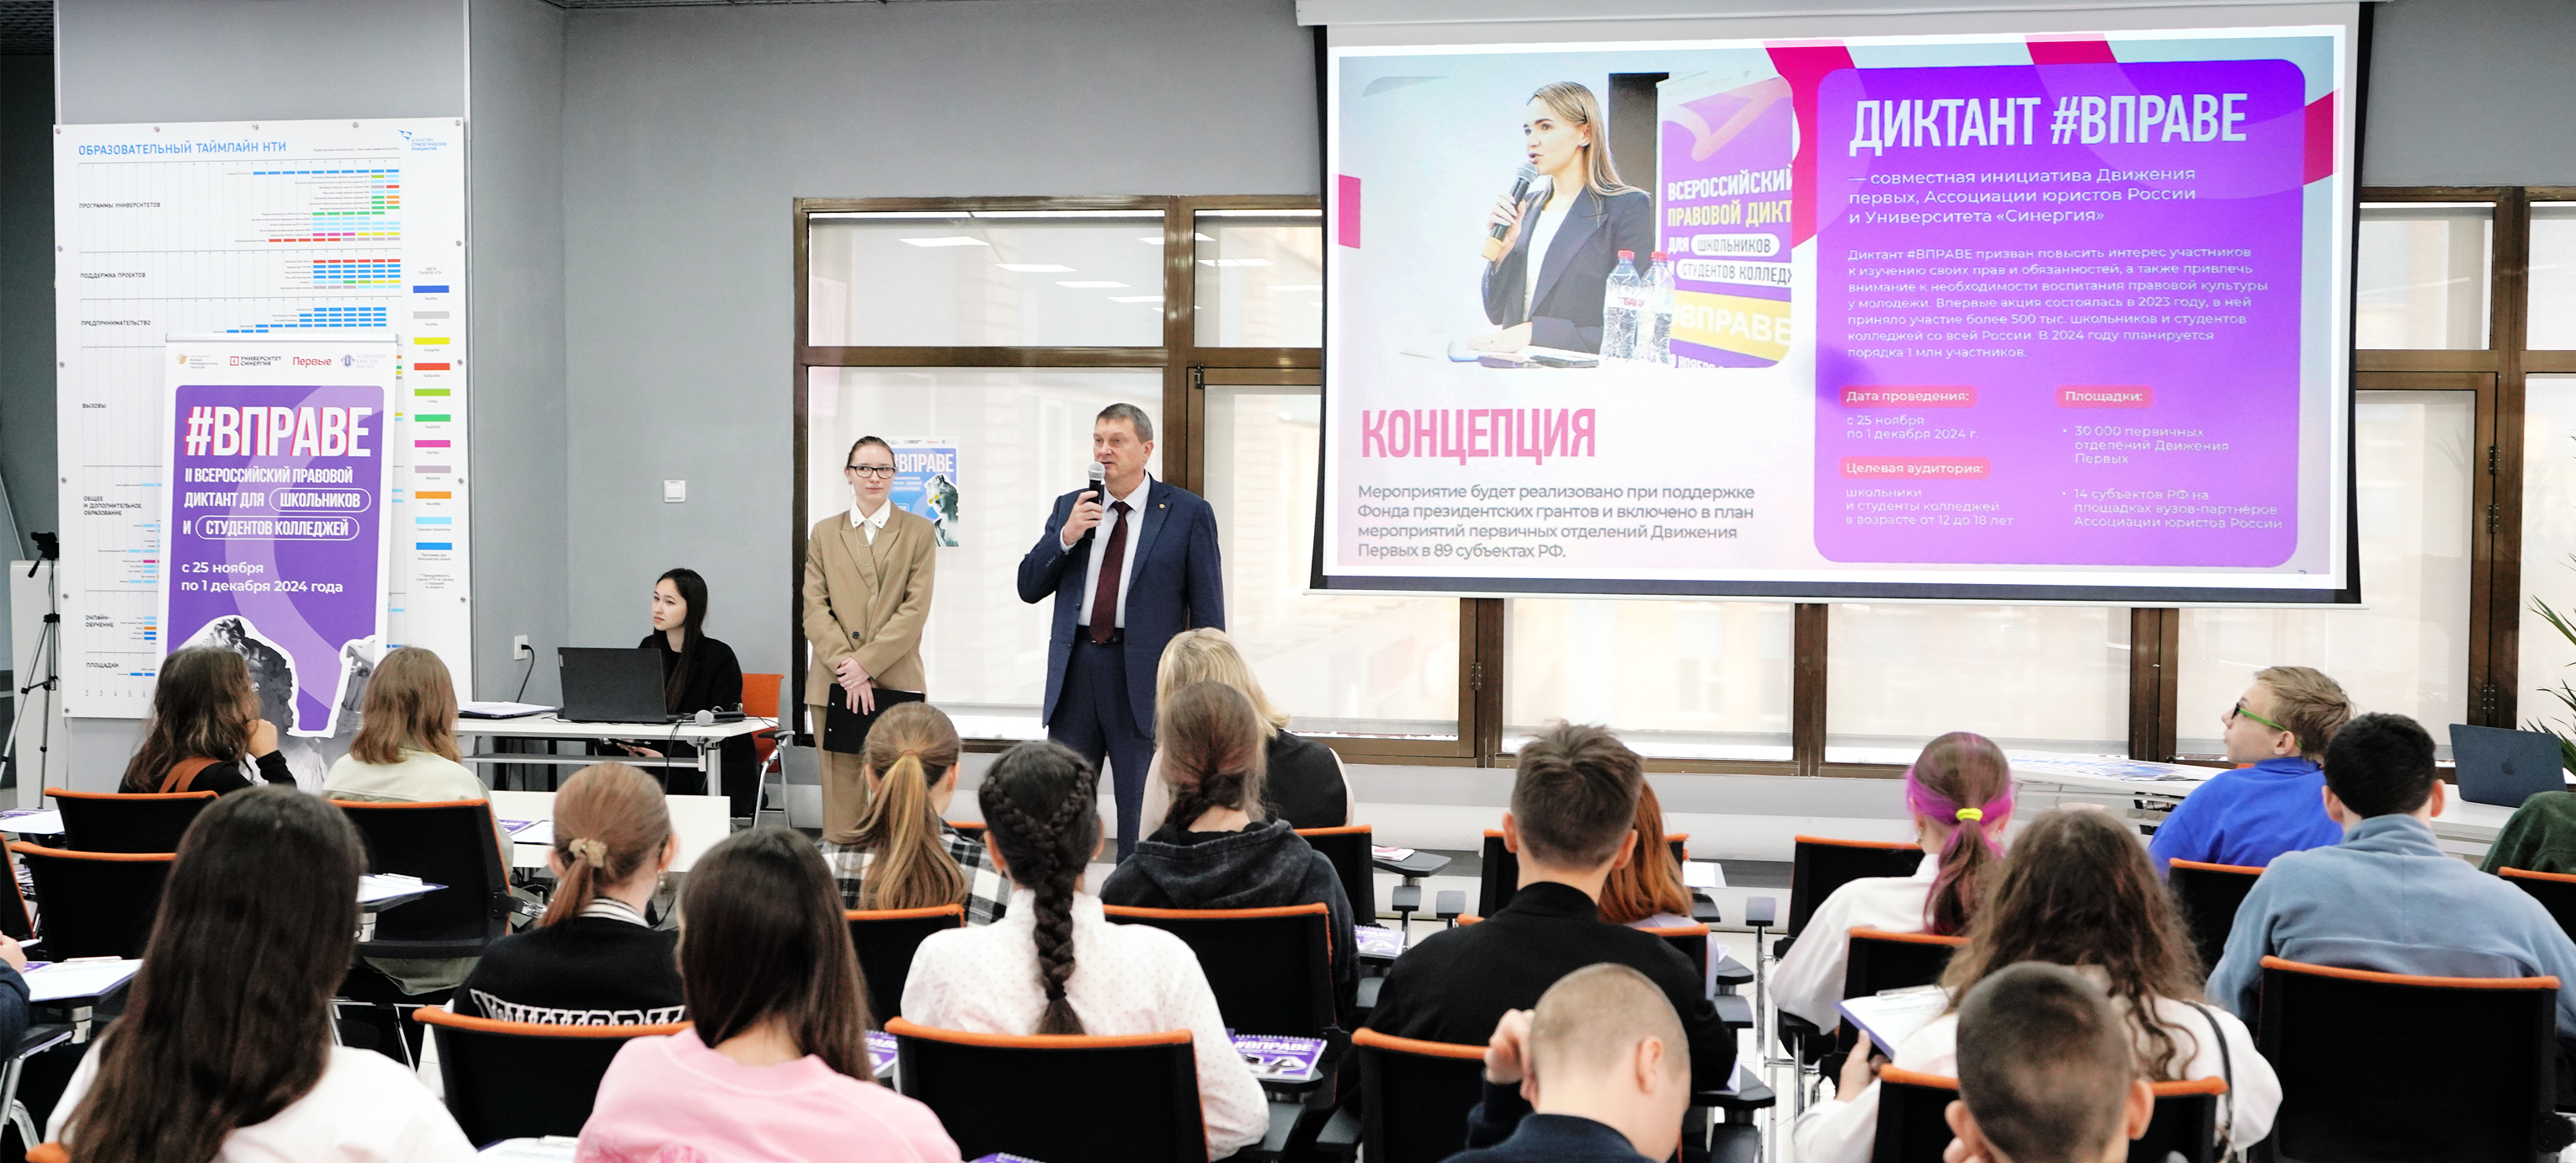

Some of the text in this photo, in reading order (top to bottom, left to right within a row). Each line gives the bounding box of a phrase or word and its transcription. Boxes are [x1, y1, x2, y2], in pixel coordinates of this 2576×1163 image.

[1850, 93, 2248, 157] ДИКТАНТ #ВПРАВЕ
[78, 139, 286, 155] ОБРАЗОВАТЕЛЬНЫЙ ТАЙМЛАЙН НТИ
[1870, 168, 2195, 184] совместная инициатива Движения
[1849, 188, 2195, 206] первых, Ассоциации юристов России
[1668, 199, 1741, 226] ПРАВОВОЙ
[1865, 210, 2104, 225] Университета «Синергия»
[1668, 236, 1771, 255] ДЛЯ ШКОЛЬНИКОВ
[1847, 248, 2251, 261] Диктант #ВПРАВЕ призван повысить интерес участников
[1683, 263, 1735, 279] СТУДЕНТОВ
[1859, 263, 2253, 278] изучению своих прав обязанностей, также привлечь
[1848, 279, 2268, 293] внимание необходимости воспитания правовой культуры
[1935, 297, 1997, 309] Впервые
[2000, 299, 2041, 308] акция
[2044, 299, 2123, 307] состоялась
[2137, 296, 2170, 306] 2023
[2174, 298, 2209, 309] году,
[2224, 296, 2251, 306] ней
[1674, 305, 1791, 346] ВПРАВЕ
[1847, 313, 2247, 327] приняло участие более 500 тыс. школьников студентов
[1847, 329, 2214, 342] колледжей со всей России. 2024 году планируется
[1845, 345, 2027, 358] порядка млн участников.
[292, 357, 332, 368] Первые
[1845, 390, 1969, 402] Дата проведения:
[2065, 390, 2142, 402] Площадки:
[1856, 414, 1924, 427] 25 ноября
[184, 406, 372, 457] #ВПРАВЕ
[1362, 408, 1595, 465] КОНЦЕПЦИЯ
[1846, 427, 1966, 440] по декабря 2024
[2074, 425, 2204, 438] 30 000 первичных
[2074, 439, 2229, 451] отделений Движения
[2074, 453, 2129, 465] Первых
[184, 466, 353, 483] II ВСЕРОССИЙСКИЙ ПРАВОВОЙ
[1846, 463, 1983, 475] Целевая аудитория:
[184, 491, 360, 507] ДИКТАНТ ДЛЯ ШКОЛЬНИКОВ
[1358, 484, 1755, 501] Мероприятие будет реализовано при поддержке
[1845, 489, 1922, 497] школьники
[2073, 487, 2209, 501] 14 субъектов РФ на
[1357, 504, 1754, 520] Фонда президентских грантов включено план
[1857, 502, 1999, 512] студенты колледжей
[2073, 504, 2152, 513] площадках
[1857, 514, 2014, 526] возрасте от 12 до 18 лет
[2073, 516, 2282, 528] Ассоциации юристов России
[183, 519, 349, 536] И СТУДЕНТОВ КОЛЛЕДЖЕЙ
[1358, 523, 1737, 540] мероприятий первичных отделений Движения
[1358, 543, 1566, 560] Первых 89 субъектах РФ.
[181, 561, 263, 575] с 25 ноября
[181, 579, 343, 593] по 1 декабря 2024 года
